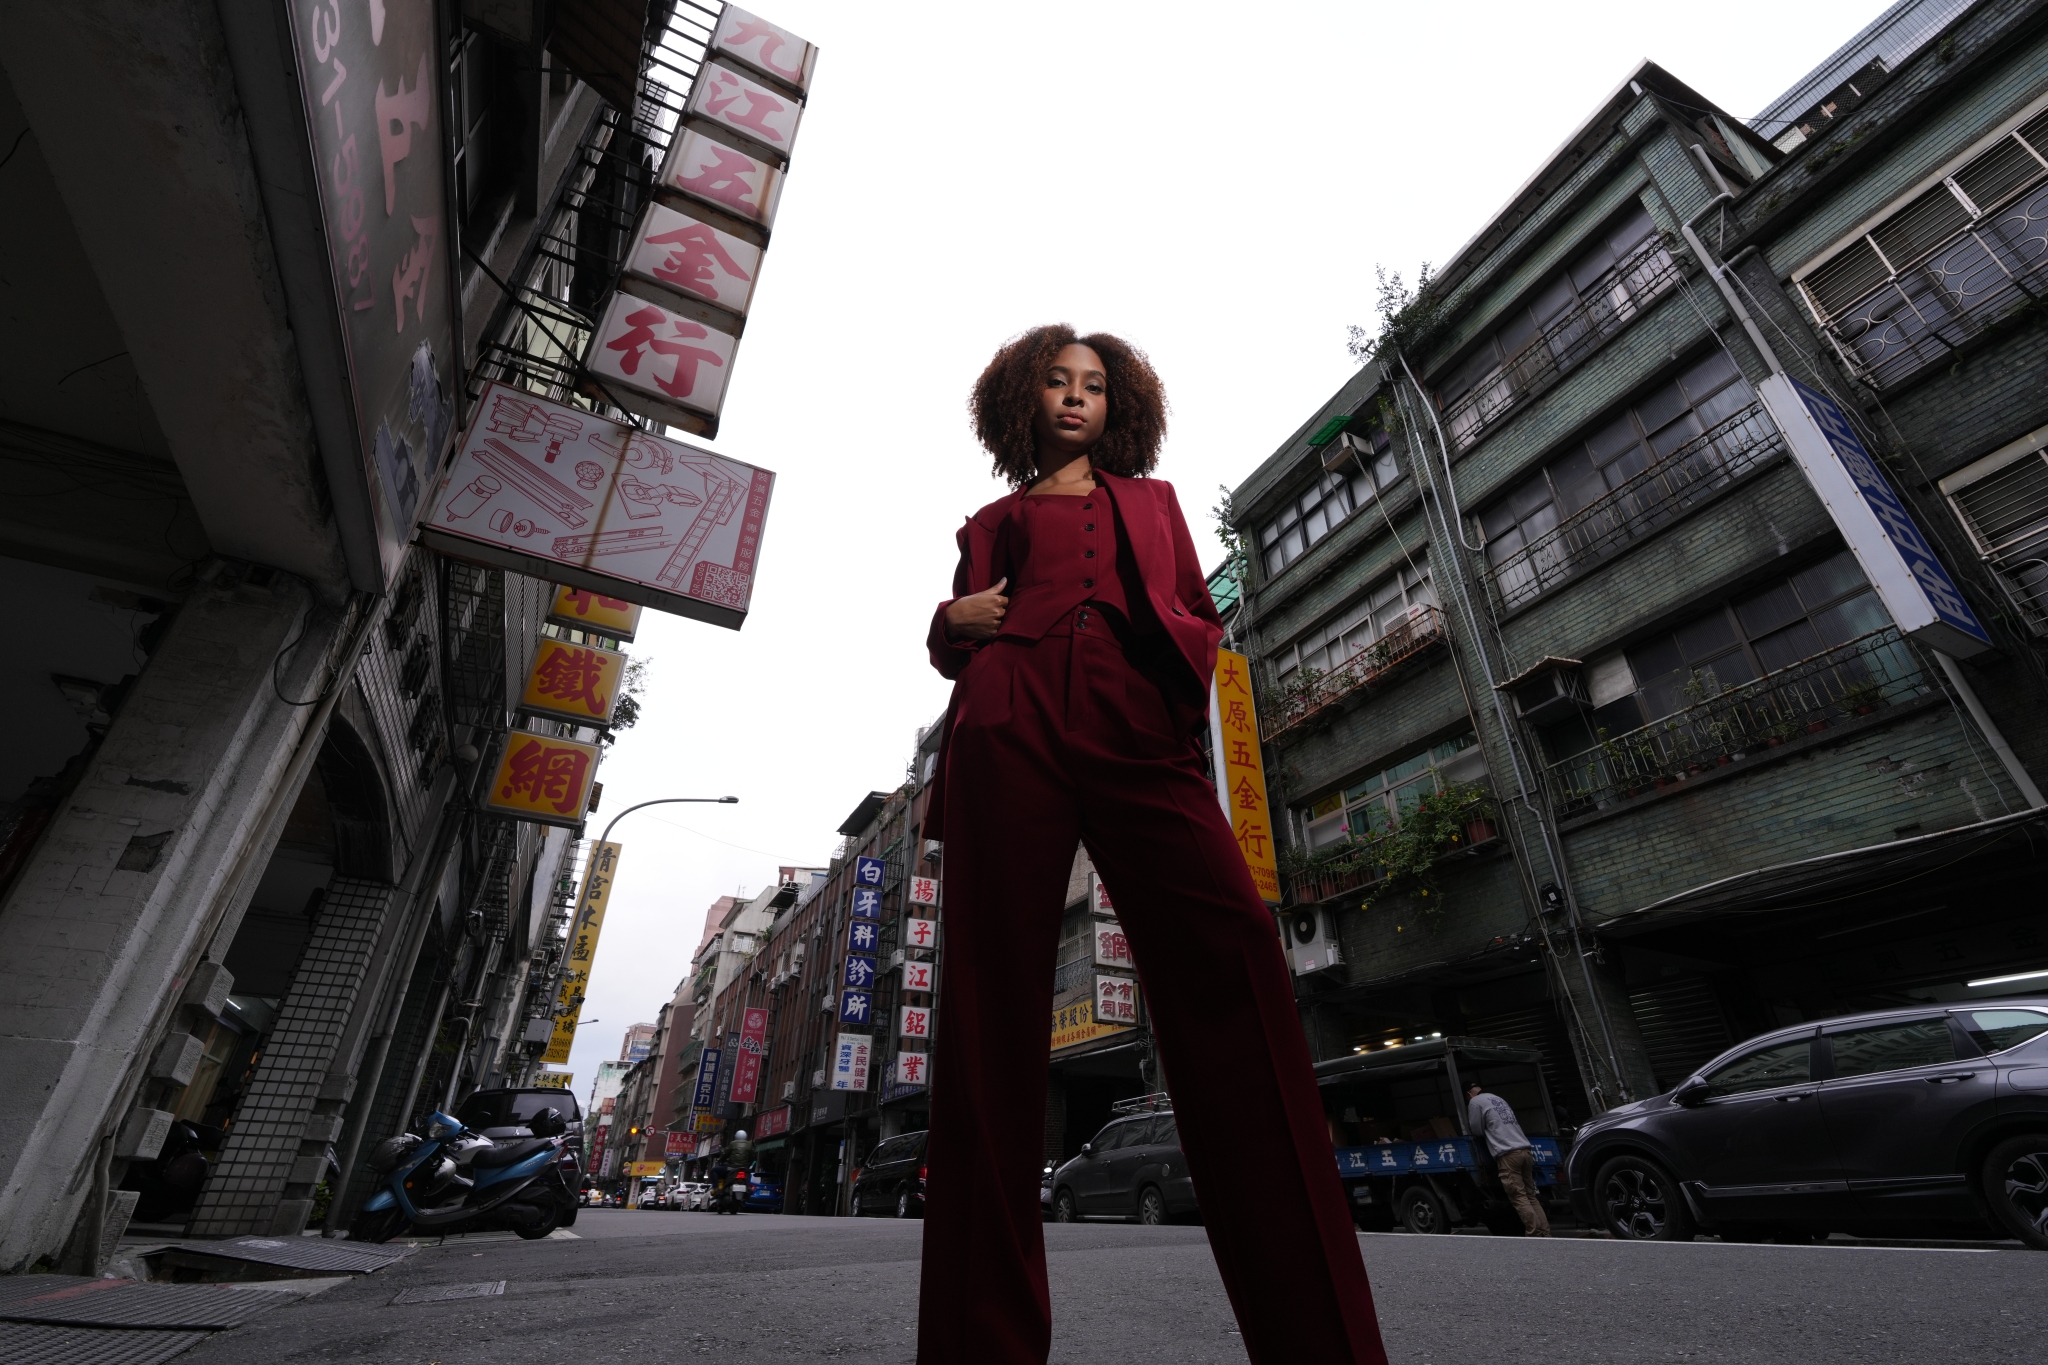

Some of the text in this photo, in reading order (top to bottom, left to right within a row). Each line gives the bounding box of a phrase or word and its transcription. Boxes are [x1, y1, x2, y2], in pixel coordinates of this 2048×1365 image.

[369, 0, 440, 333] 五金
[606, 17, 806, 398] 九江五金行
[691, 562, 706, 595] QR-Code
[737, 523, 757, 570] 專業服務
[1799, 387, 1975, 627] 正興五金
[1221, 659, 1267, 859] 大原五金行
[845, 860, 881, 1021] 白牙科診所
[903, 878, 934, 1082] 揚子江鋁業
[853, 1045, 868, 1089] 全民健保
[1336, 1144, 1456, 1170] 江五金行
